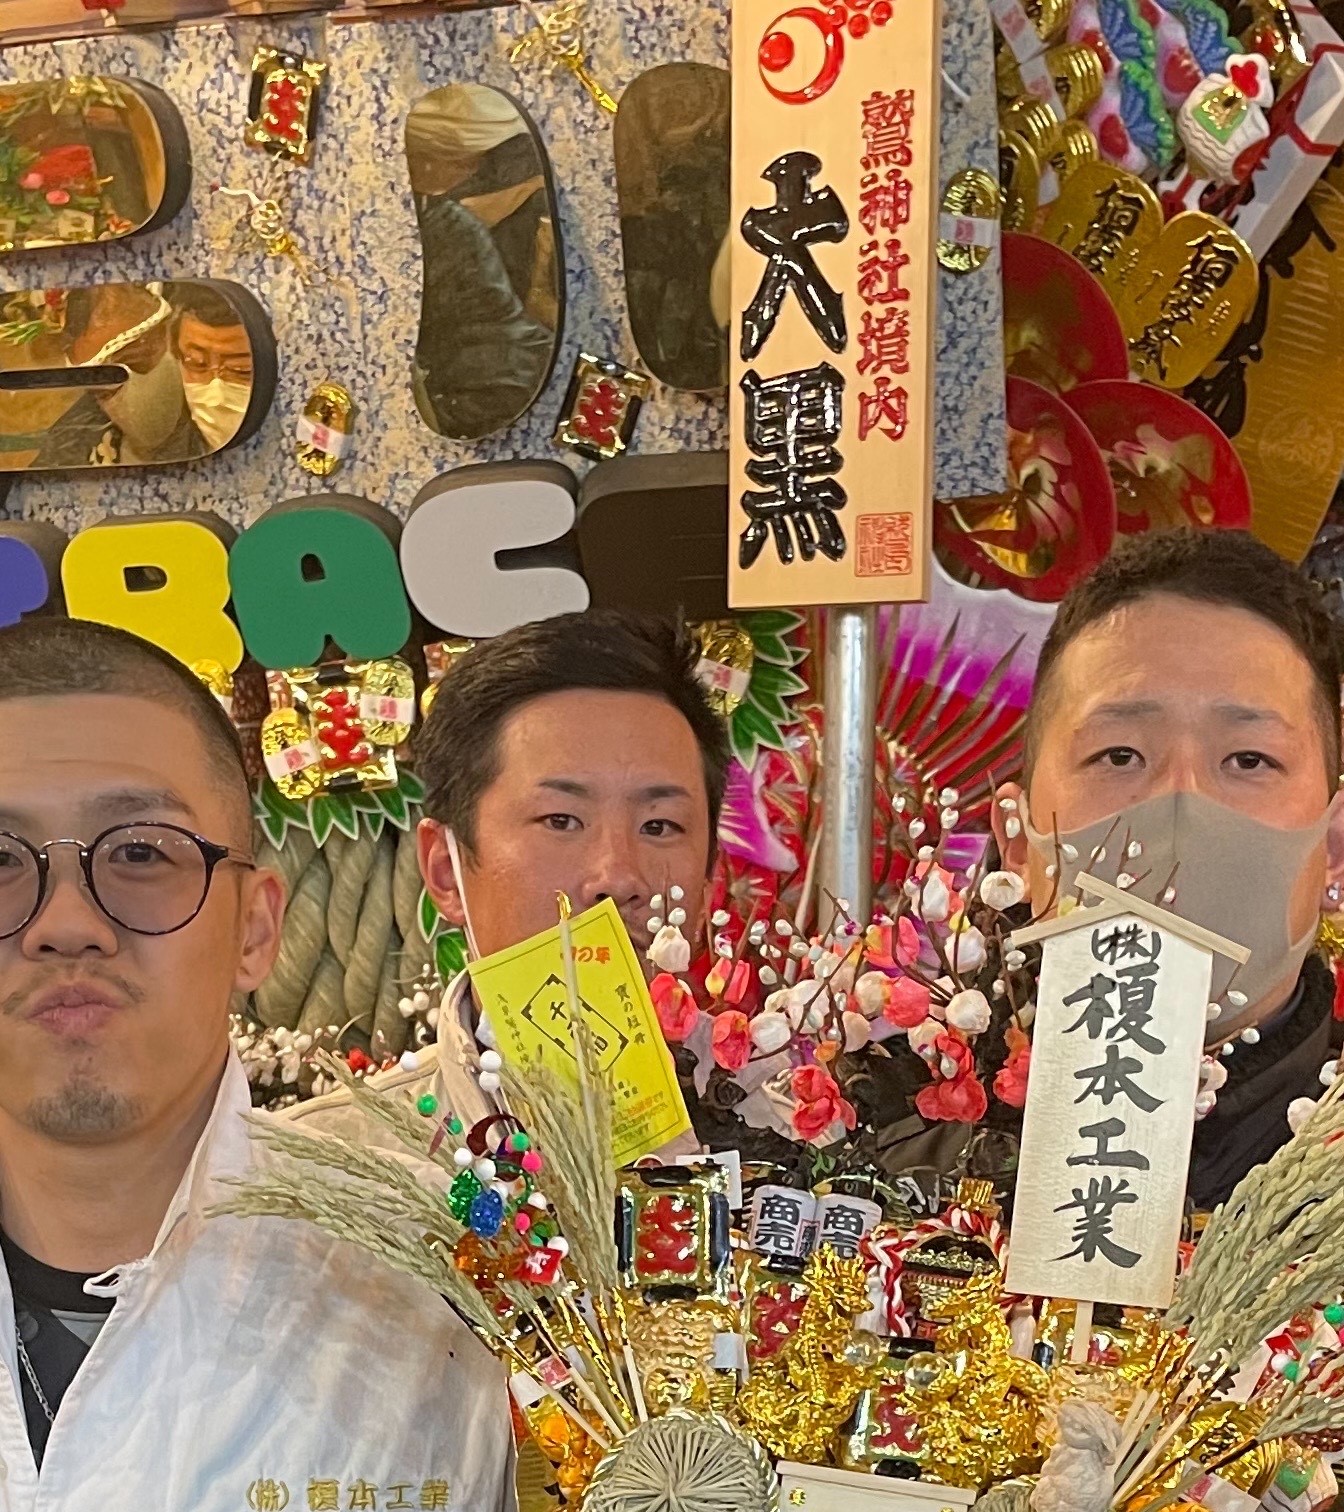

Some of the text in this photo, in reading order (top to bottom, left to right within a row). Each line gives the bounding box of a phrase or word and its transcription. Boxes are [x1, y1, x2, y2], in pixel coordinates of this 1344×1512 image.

[739, 150, 849, 570] 大黒
[856, 88, 916, 443] 鷲神社境内
[1050, 922, 1166, 1270] (株)榎本工業
